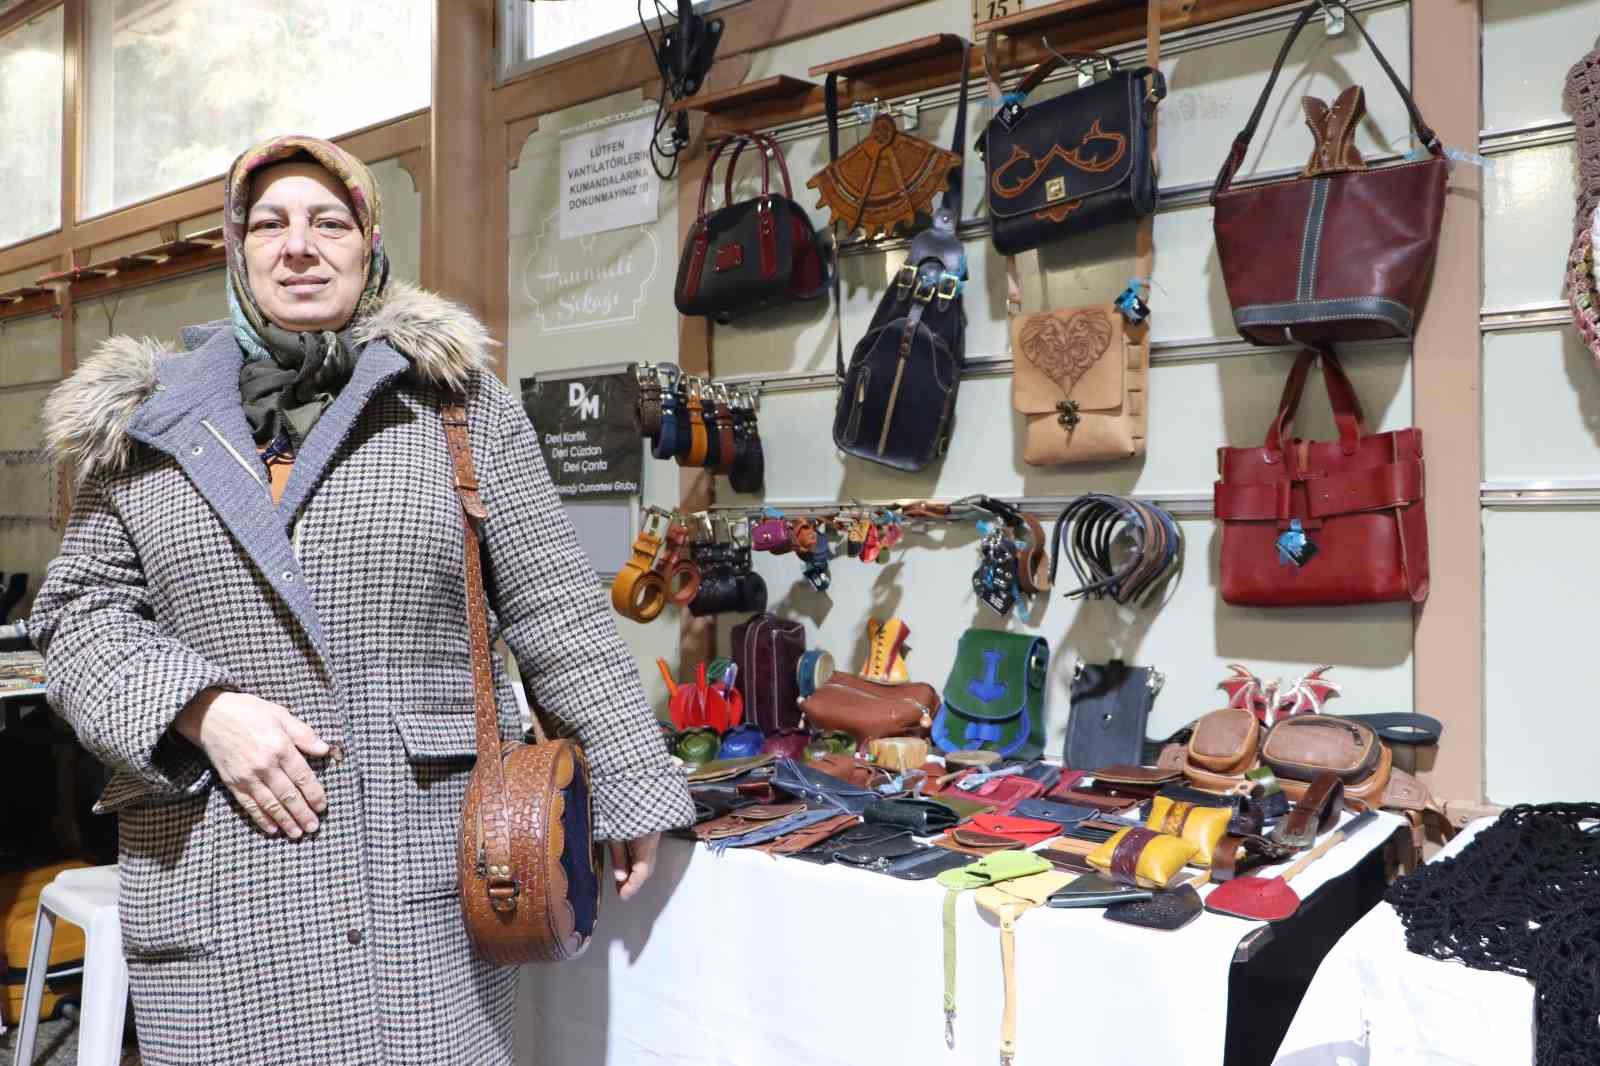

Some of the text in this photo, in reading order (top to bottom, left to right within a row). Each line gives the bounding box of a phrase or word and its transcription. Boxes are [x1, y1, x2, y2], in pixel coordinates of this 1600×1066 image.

[986, 0, 1008, 19] 15
[589, 139, 625, 159] LÜTFEN
[552, 446, 602, 458] Deri Cüzdan
[563, 461, 608, 474] Deri Çanta
[614, 481, 637, 491] Grubu
